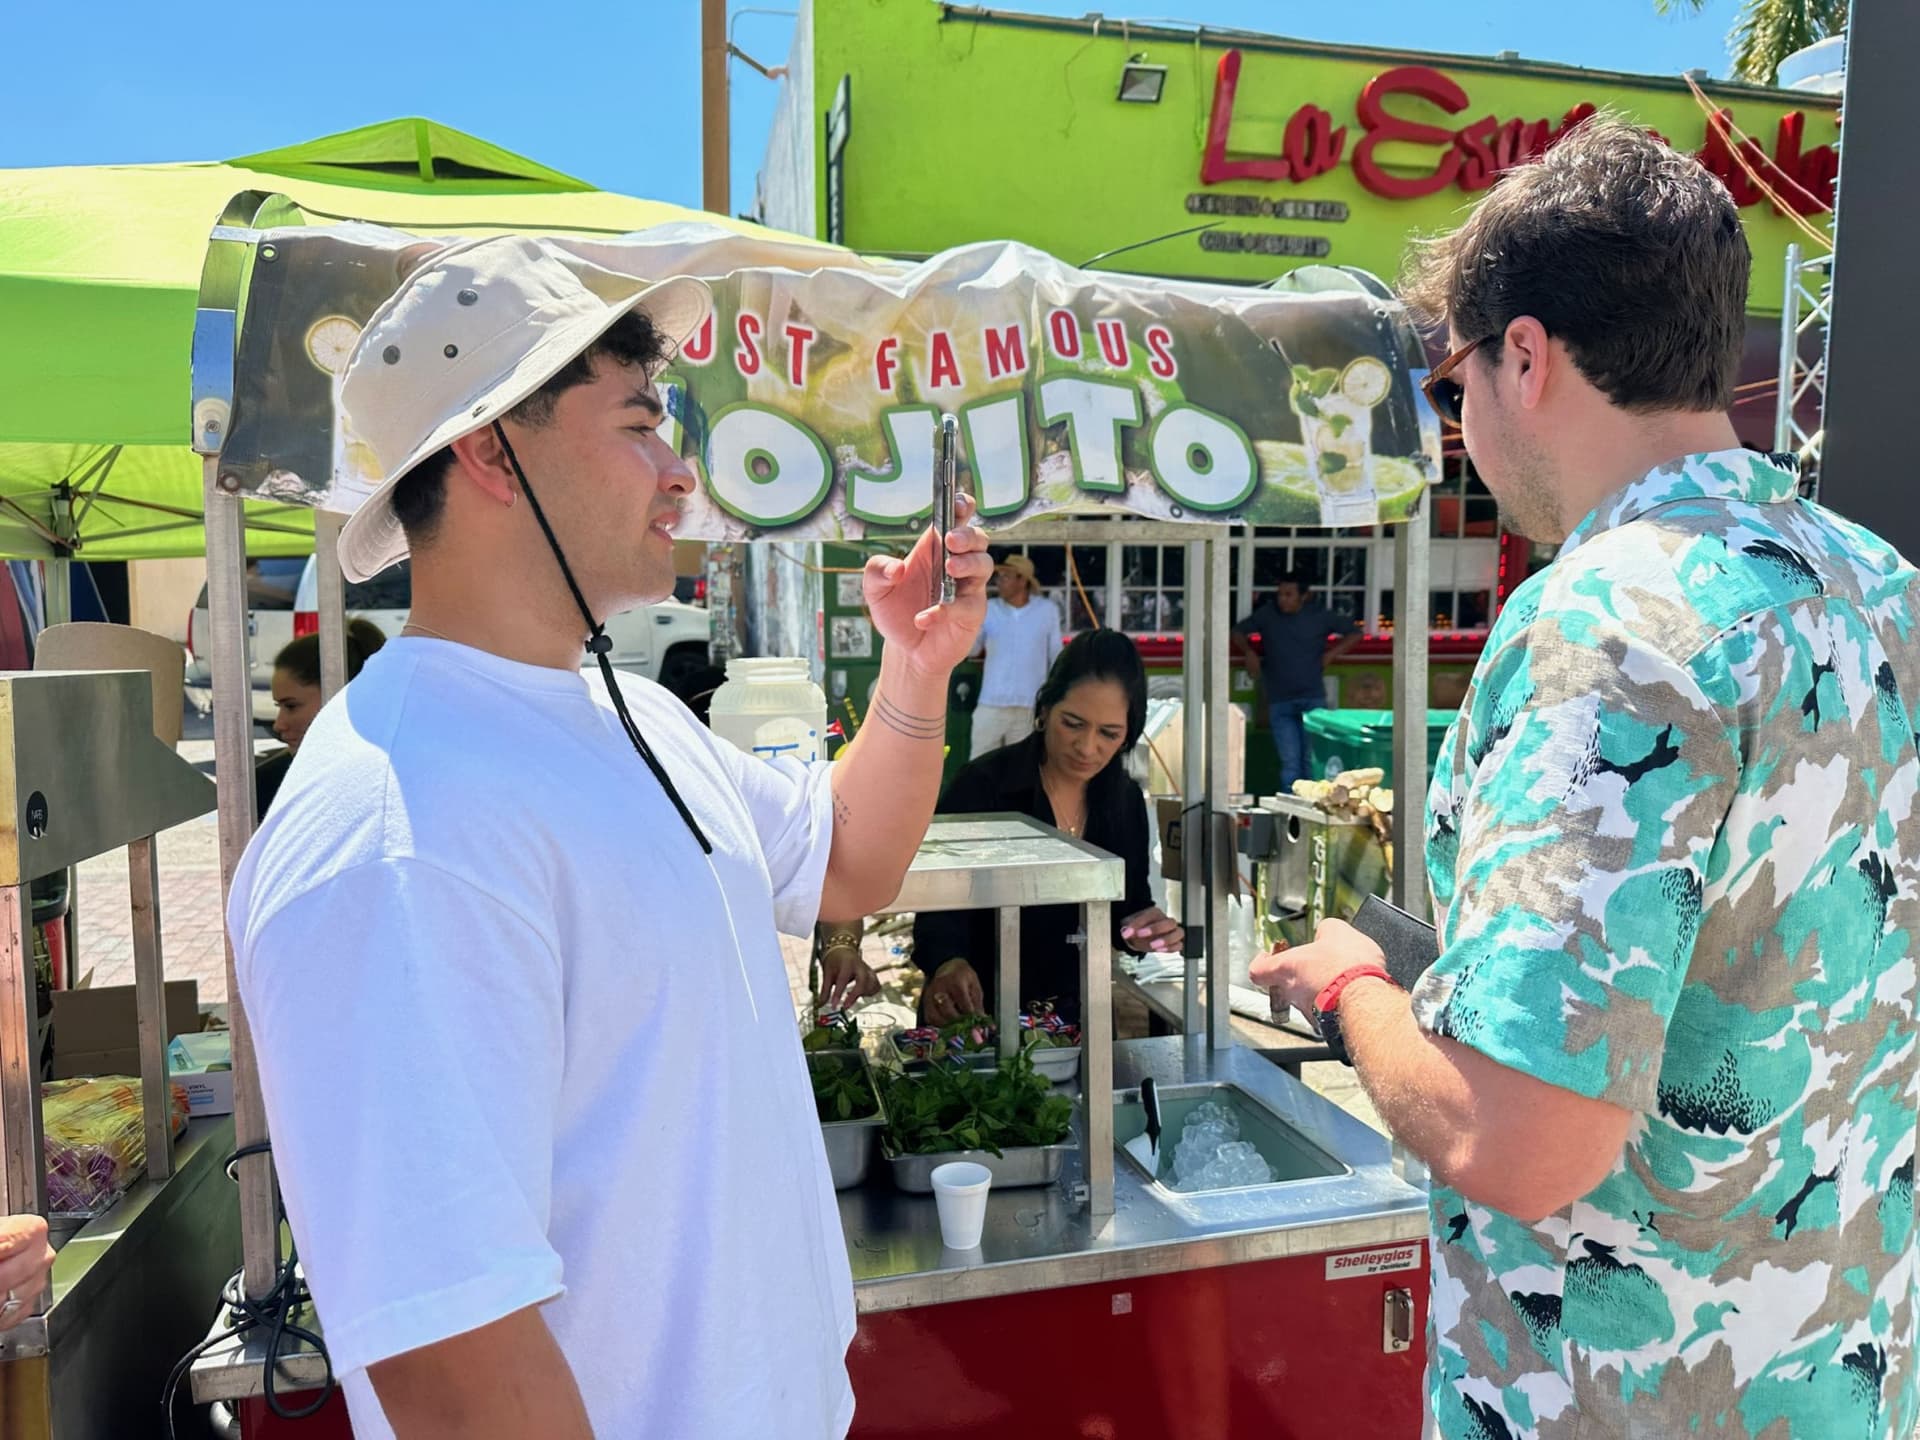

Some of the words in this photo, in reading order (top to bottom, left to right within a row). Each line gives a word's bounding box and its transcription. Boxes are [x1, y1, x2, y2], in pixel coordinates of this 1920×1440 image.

[1201, 48, 1347, 186] La
[682, 311, 813, 386] OST
[876, 310, 1177, 390] FAMOUS
[655, 373, 1259, 527] OJITO
[1334, 1249, 1413, 1268] Shelleyglas
